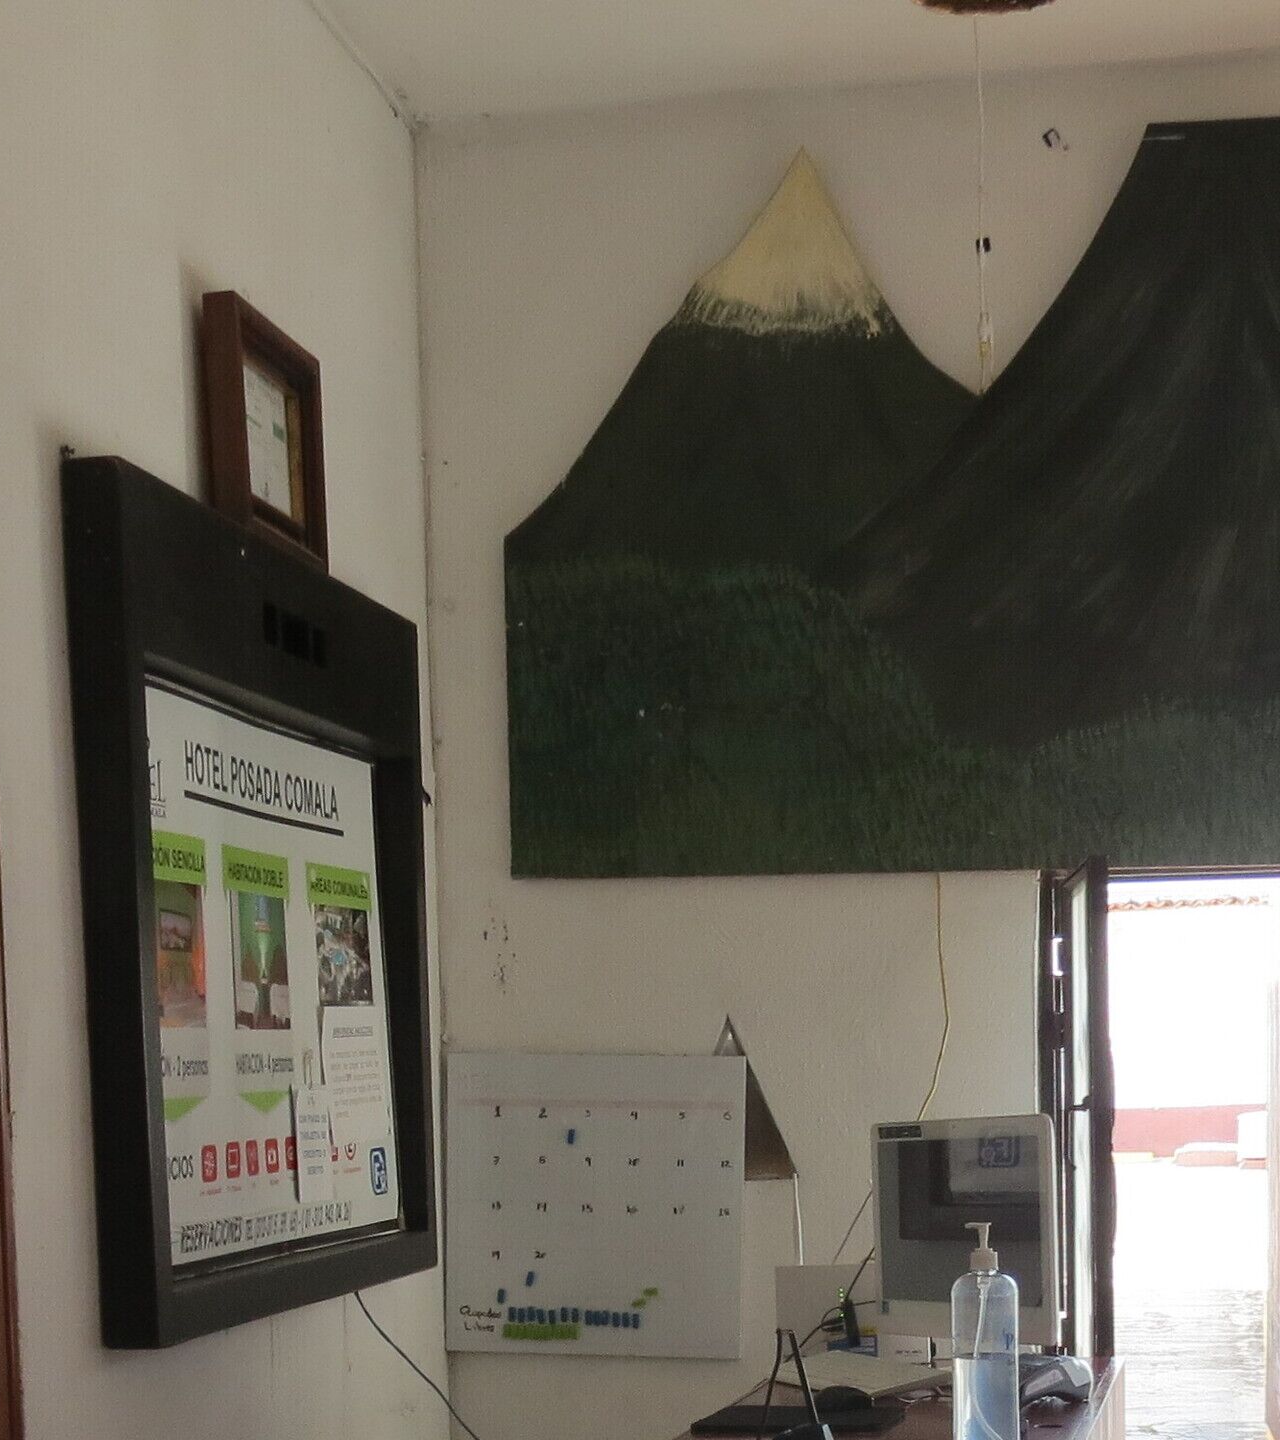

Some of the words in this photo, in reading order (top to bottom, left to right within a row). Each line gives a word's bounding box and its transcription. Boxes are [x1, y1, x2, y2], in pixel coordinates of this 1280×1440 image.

[184, 739, 228, 793] HOTEL
[230, 755, 282, 808] POSADA
[284, 773, 339, 822] COMALA
[494, 1106, 501, 1117] 1
[538, 1108, 548, 1118] 2
[629, 1111, 638, 1120] 4
[723, 1111, 732, 1121] 6
[585, 1156, 592, 1167] 9
[677, 1159, 684, 1167] 11
